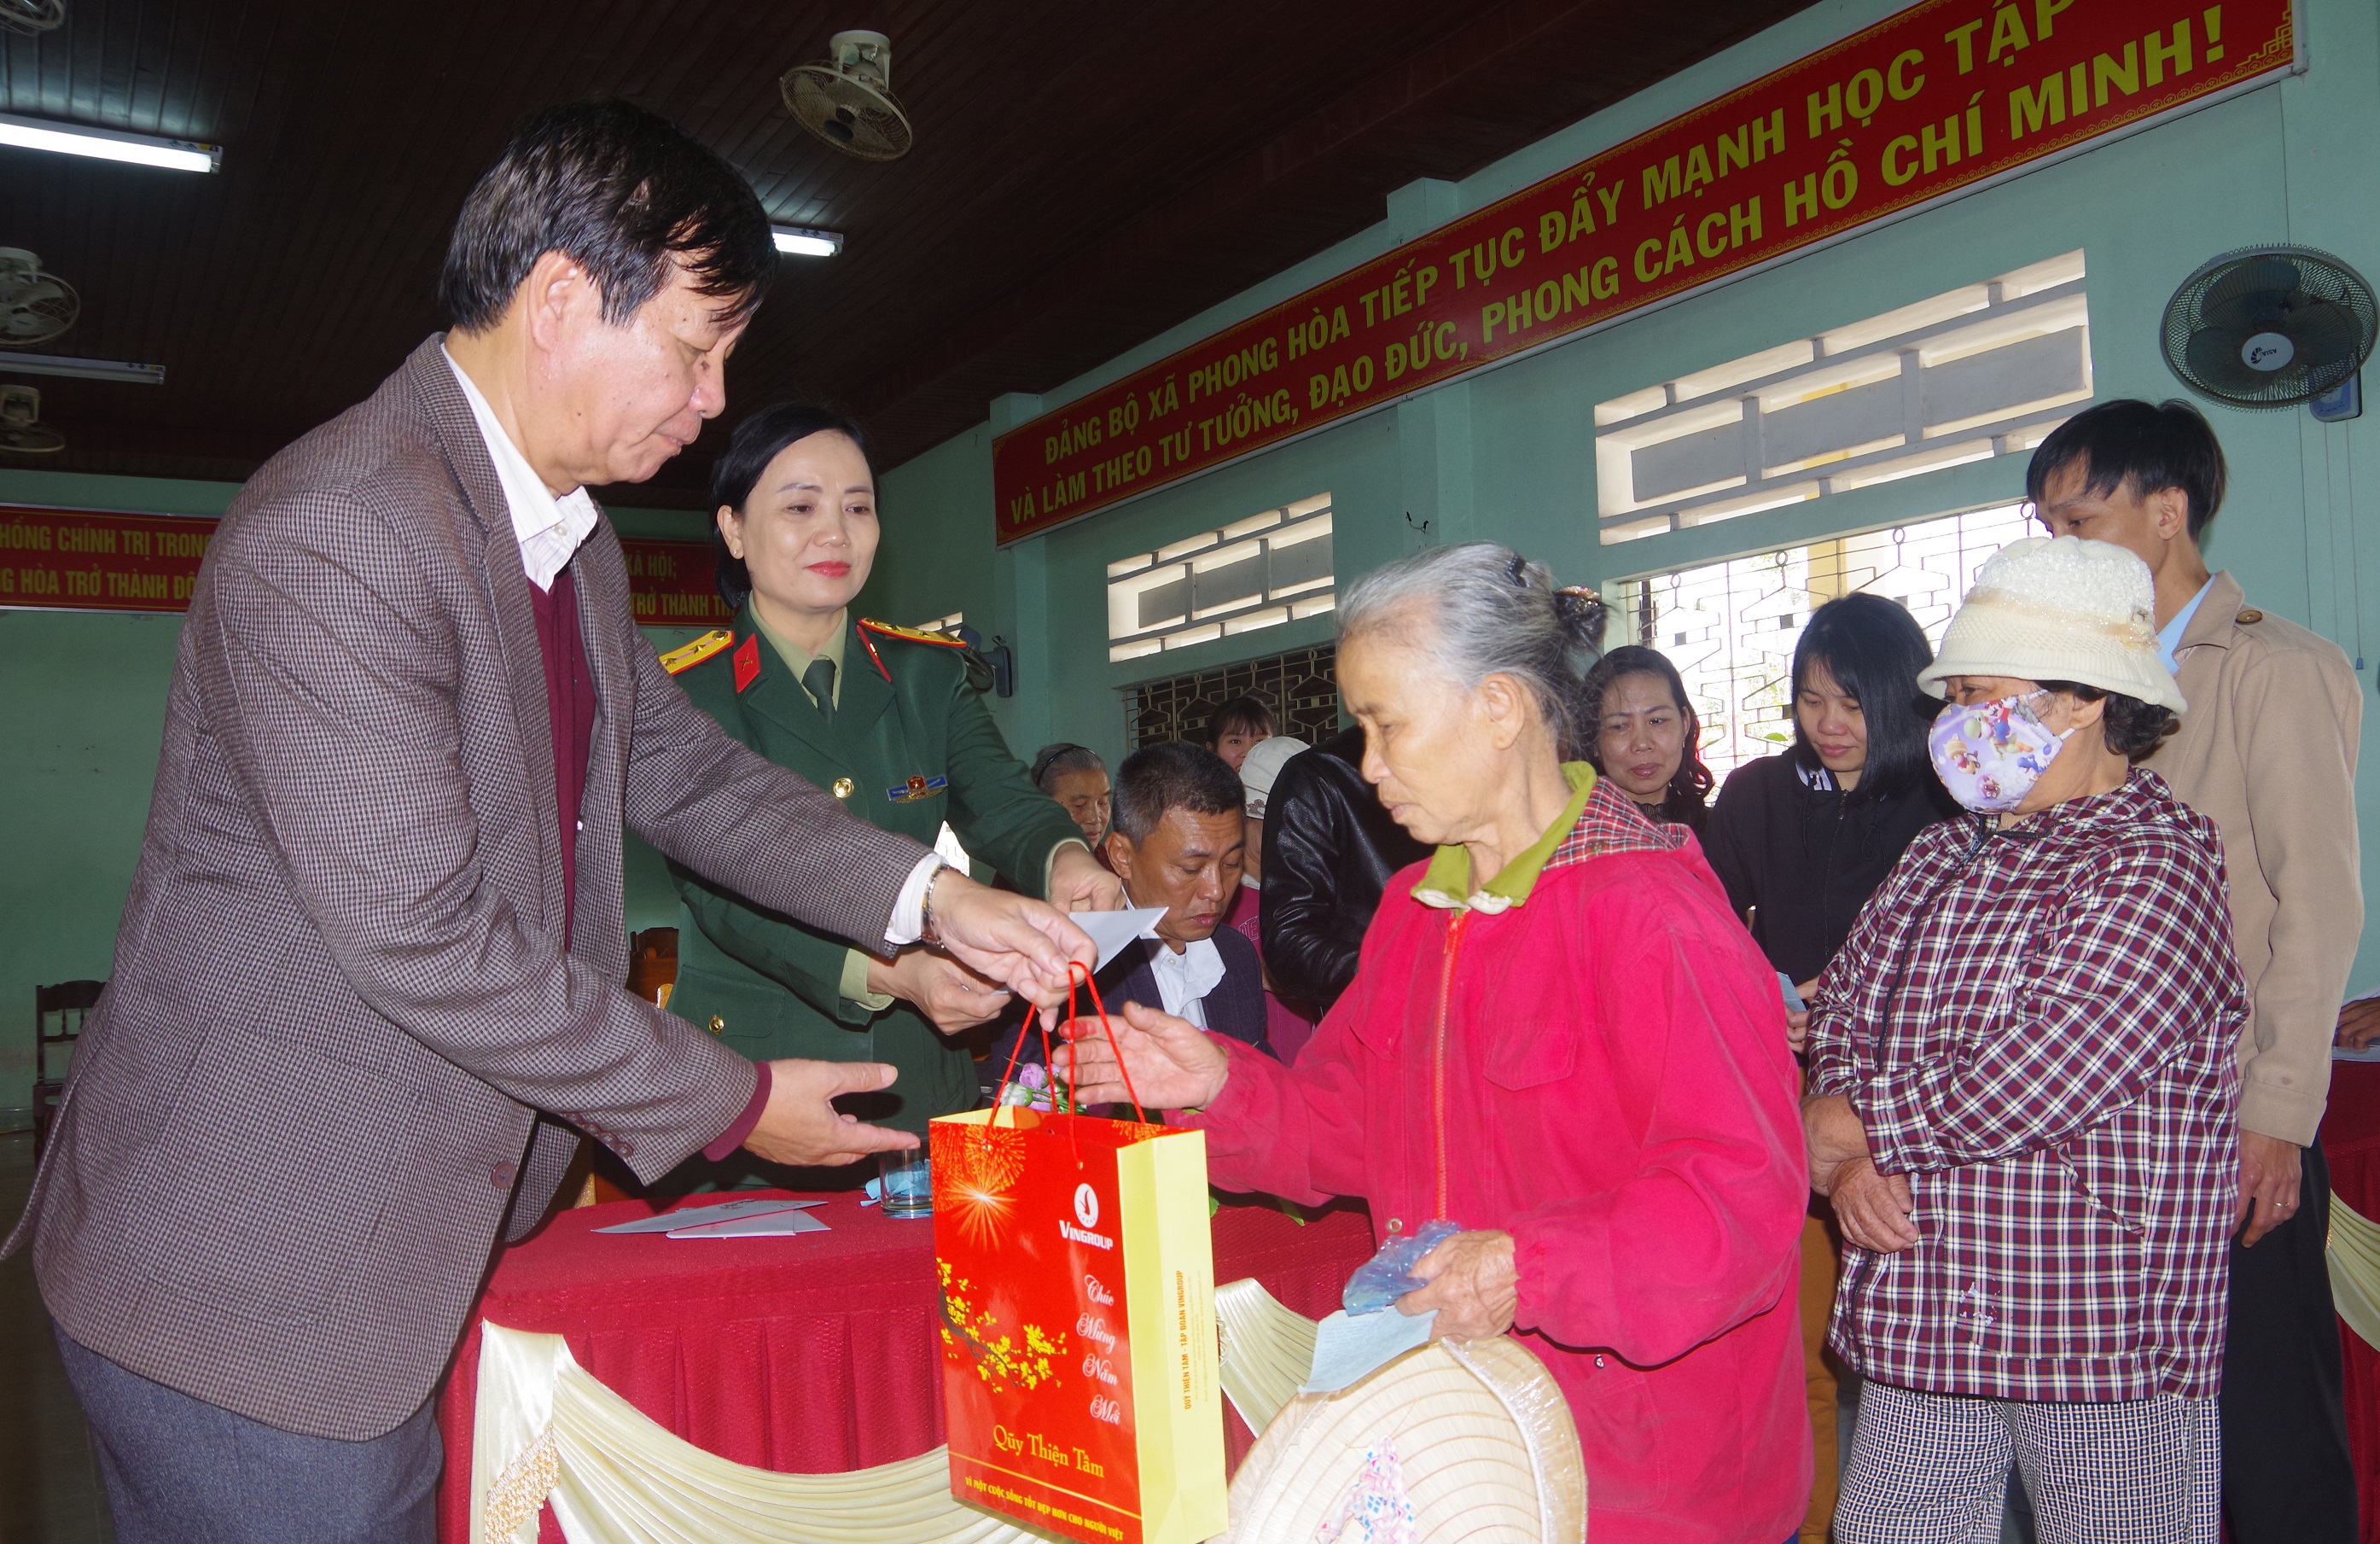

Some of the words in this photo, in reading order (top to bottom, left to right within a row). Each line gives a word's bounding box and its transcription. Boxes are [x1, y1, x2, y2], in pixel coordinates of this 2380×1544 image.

[1010, 487, 1036, 525] VÀ
[1042, 469, 1086, 513] LÀM
[1092, 442, 1153, 497] THEO
[1158, 421, 1193, 468] TƯ
[1198, 391, 1300, 452] TƯỞNG,
[1309, 354, 1374, 411] ĐẠO
[1384, 319, 1469, 382] ĐỨC,
[1481, 256, 1621, 345] PHONG
[1633, 194, 1764, 283] CÁCH
[1784, 137, 1859, 229] HỒ
[1880, 89, 1986, 187] CHÍ
[2008, 3, 2226, 142] MINH!
[1045, 408, 1102, 465] ĐẢNG
[1109, 393, 1139, 438] BỘ
[1148, 376, 1179, 422] XÃ
[1189, 336, 1279, 403] PHONG
[1288, 307, 1351, 361] HÒA
[1359, 257, 1439, 329] TIẾP
[1448, 226, 1526, 290] TỤC
[1539, 171, 1625, 254] ĐẨY
[1642, 107, 1786, 211] MẠNH
[1807, 48, 1926, 140] HỌC
[57, 522, 116, 554] CHÍNH
[121, 529, 150, 562] TRỊ
[20, 563, 61, 595] HÒA
[66, 562, 102, 597] TRỞ
[107, 568, 168, 599] THÀNH
[660, 589, 709, 616] THÀNH
[1058, 1220, 1114, 1251] VINGROUP
[1085, 1274, 1114, 1307] Chúc
[1176, 1270, 1185, 1308] VINGROUP
[1082, 1353, 1118, 1386] Năm
[1180, 1354, 1190, 1370] TÂM
[1090, 1394, 1120, 1425] Mới
[1027, 1433, 1069, 1467] Thiện
[1073, 1447, 1104, 1477] Tâm
[973, 1479, 987, 1492] MỘT
[988, 1485, 1004, 1498] CUỘC
[1005, 1489, 1023, 1505] SỐNG
[1023, 1495, 1036, 1509] TỐT
[1037, 1502, 1050, 1515] ĐẸP
[1068, 1513, 1083, 1526] CHO
[1084, 1518, 1107, 1535] NGƯỜI
[1108, 1527, 1124, 1541] VIỆT
